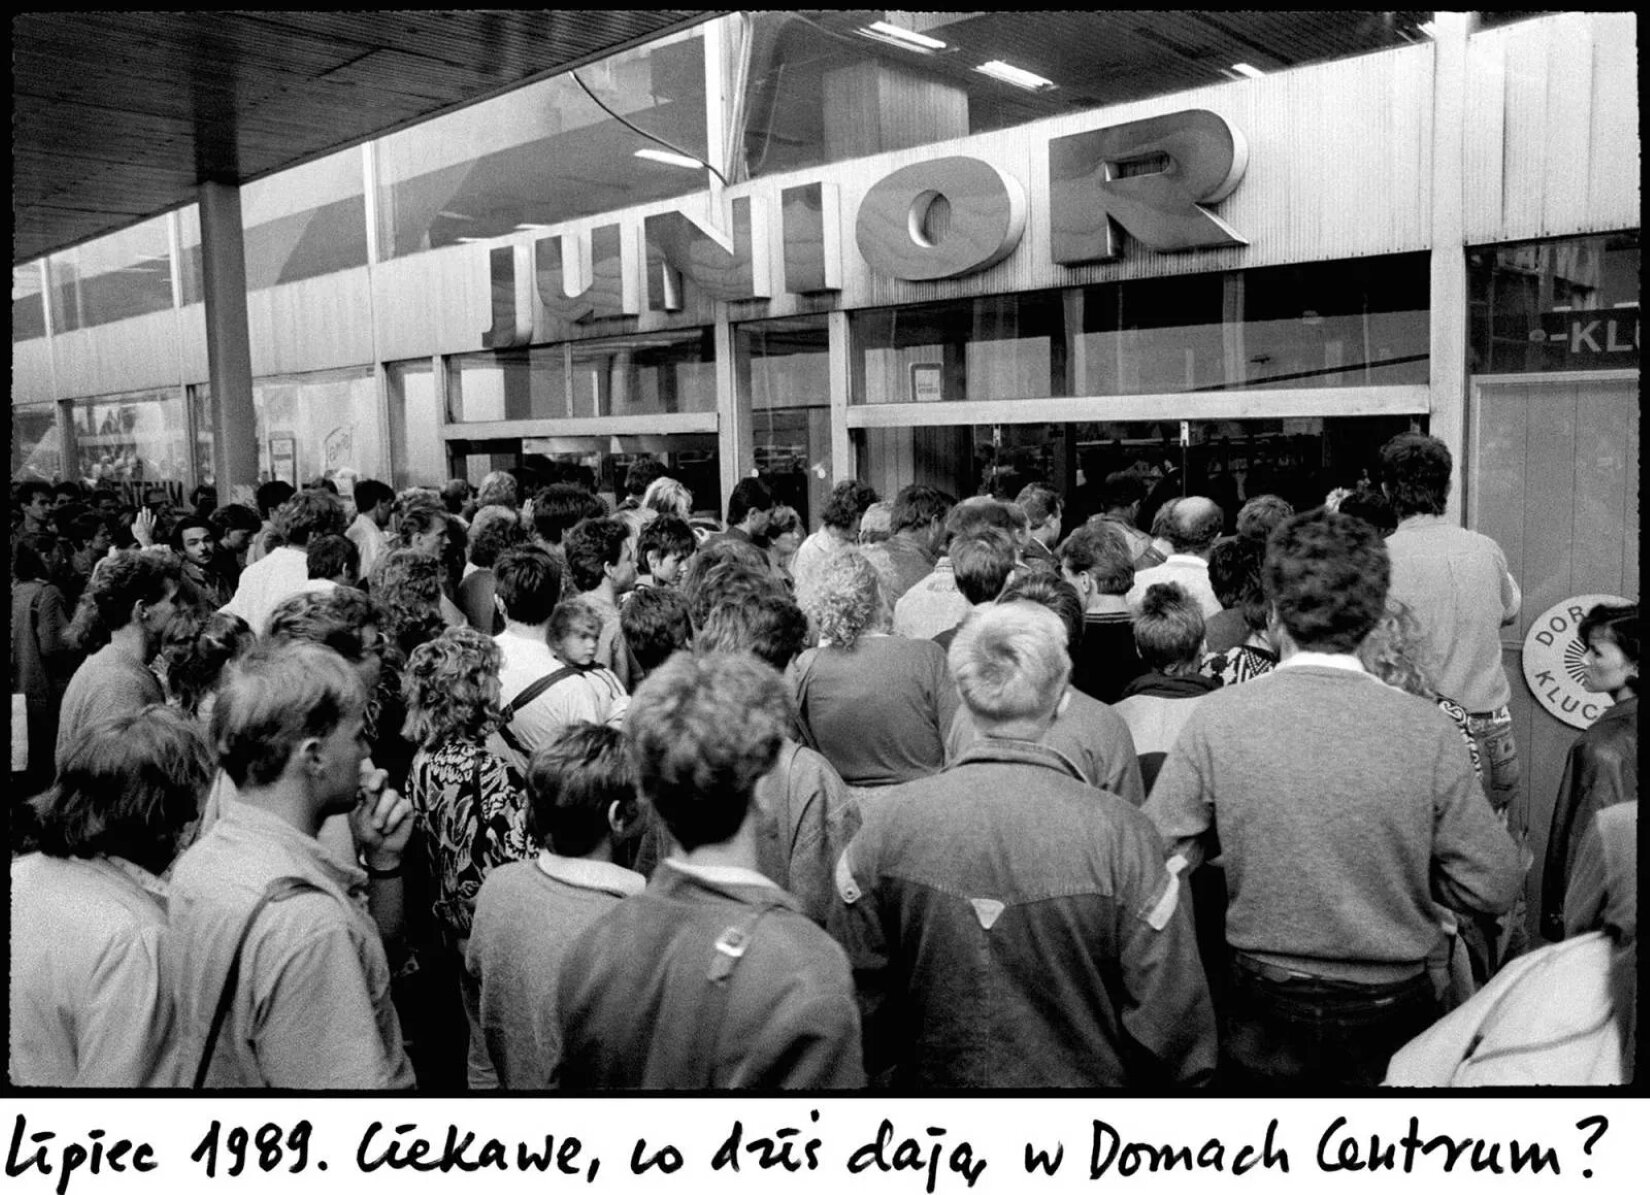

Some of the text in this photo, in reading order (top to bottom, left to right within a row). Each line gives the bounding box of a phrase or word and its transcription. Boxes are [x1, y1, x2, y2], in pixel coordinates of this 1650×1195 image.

[483, 108, 1250, 350] JUNIOR
[1535, 605, 1587, 648] DOR
[1534, 670, 1606, 721] KLUC
